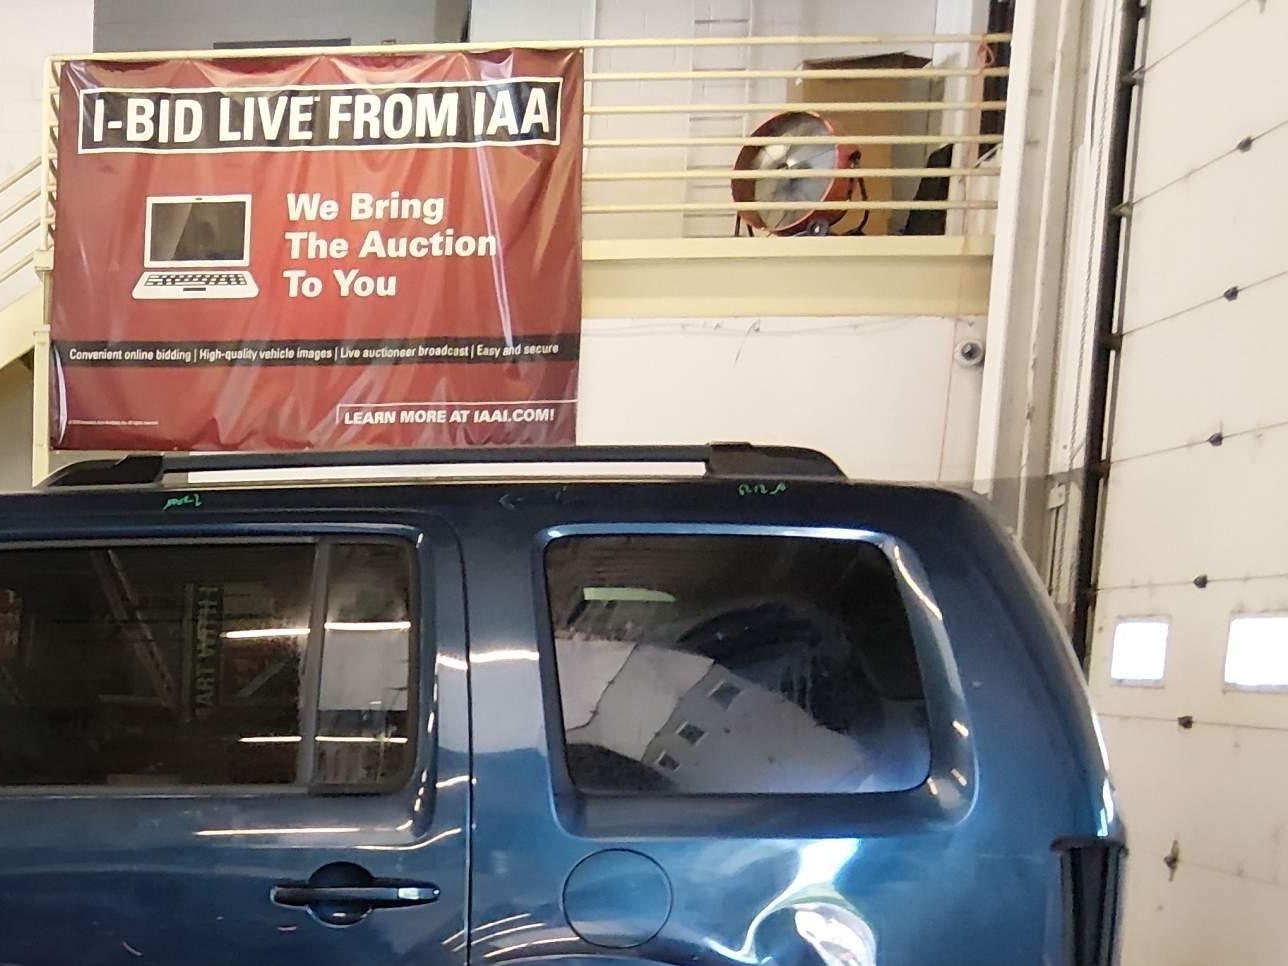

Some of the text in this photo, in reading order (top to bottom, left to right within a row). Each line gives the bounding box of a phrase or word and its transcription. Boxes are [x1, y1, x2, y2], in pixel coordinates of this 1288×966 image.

[92, 87, 550, 144] I-BID LIVE FROM IAA
[286, 191, 445, 225] We Bring
[284, 228, 497, 259] The Auction
[282, 268, 397, 297] To You
[69, 348, 122, 361] Convenient
[124, 349, 154, 361] online
[155, 348, 192, 363] bidding
[199, 347, 259, 362] High-quality
[259, 347, 294, 360] vehicle
[296, 347, 332, 361] images
[340, 346, 360, 359] Live
[362, 345, 416, 359] auctioneer
[418, 344, 469, 357] broadcast
[476, 344, 501, 358] Easy
[502, 344, 521, 356] and
[523, 344, 559, 355] secure
[344, 408, 555, 424] LEARN MORE AT IAAI.COM!
